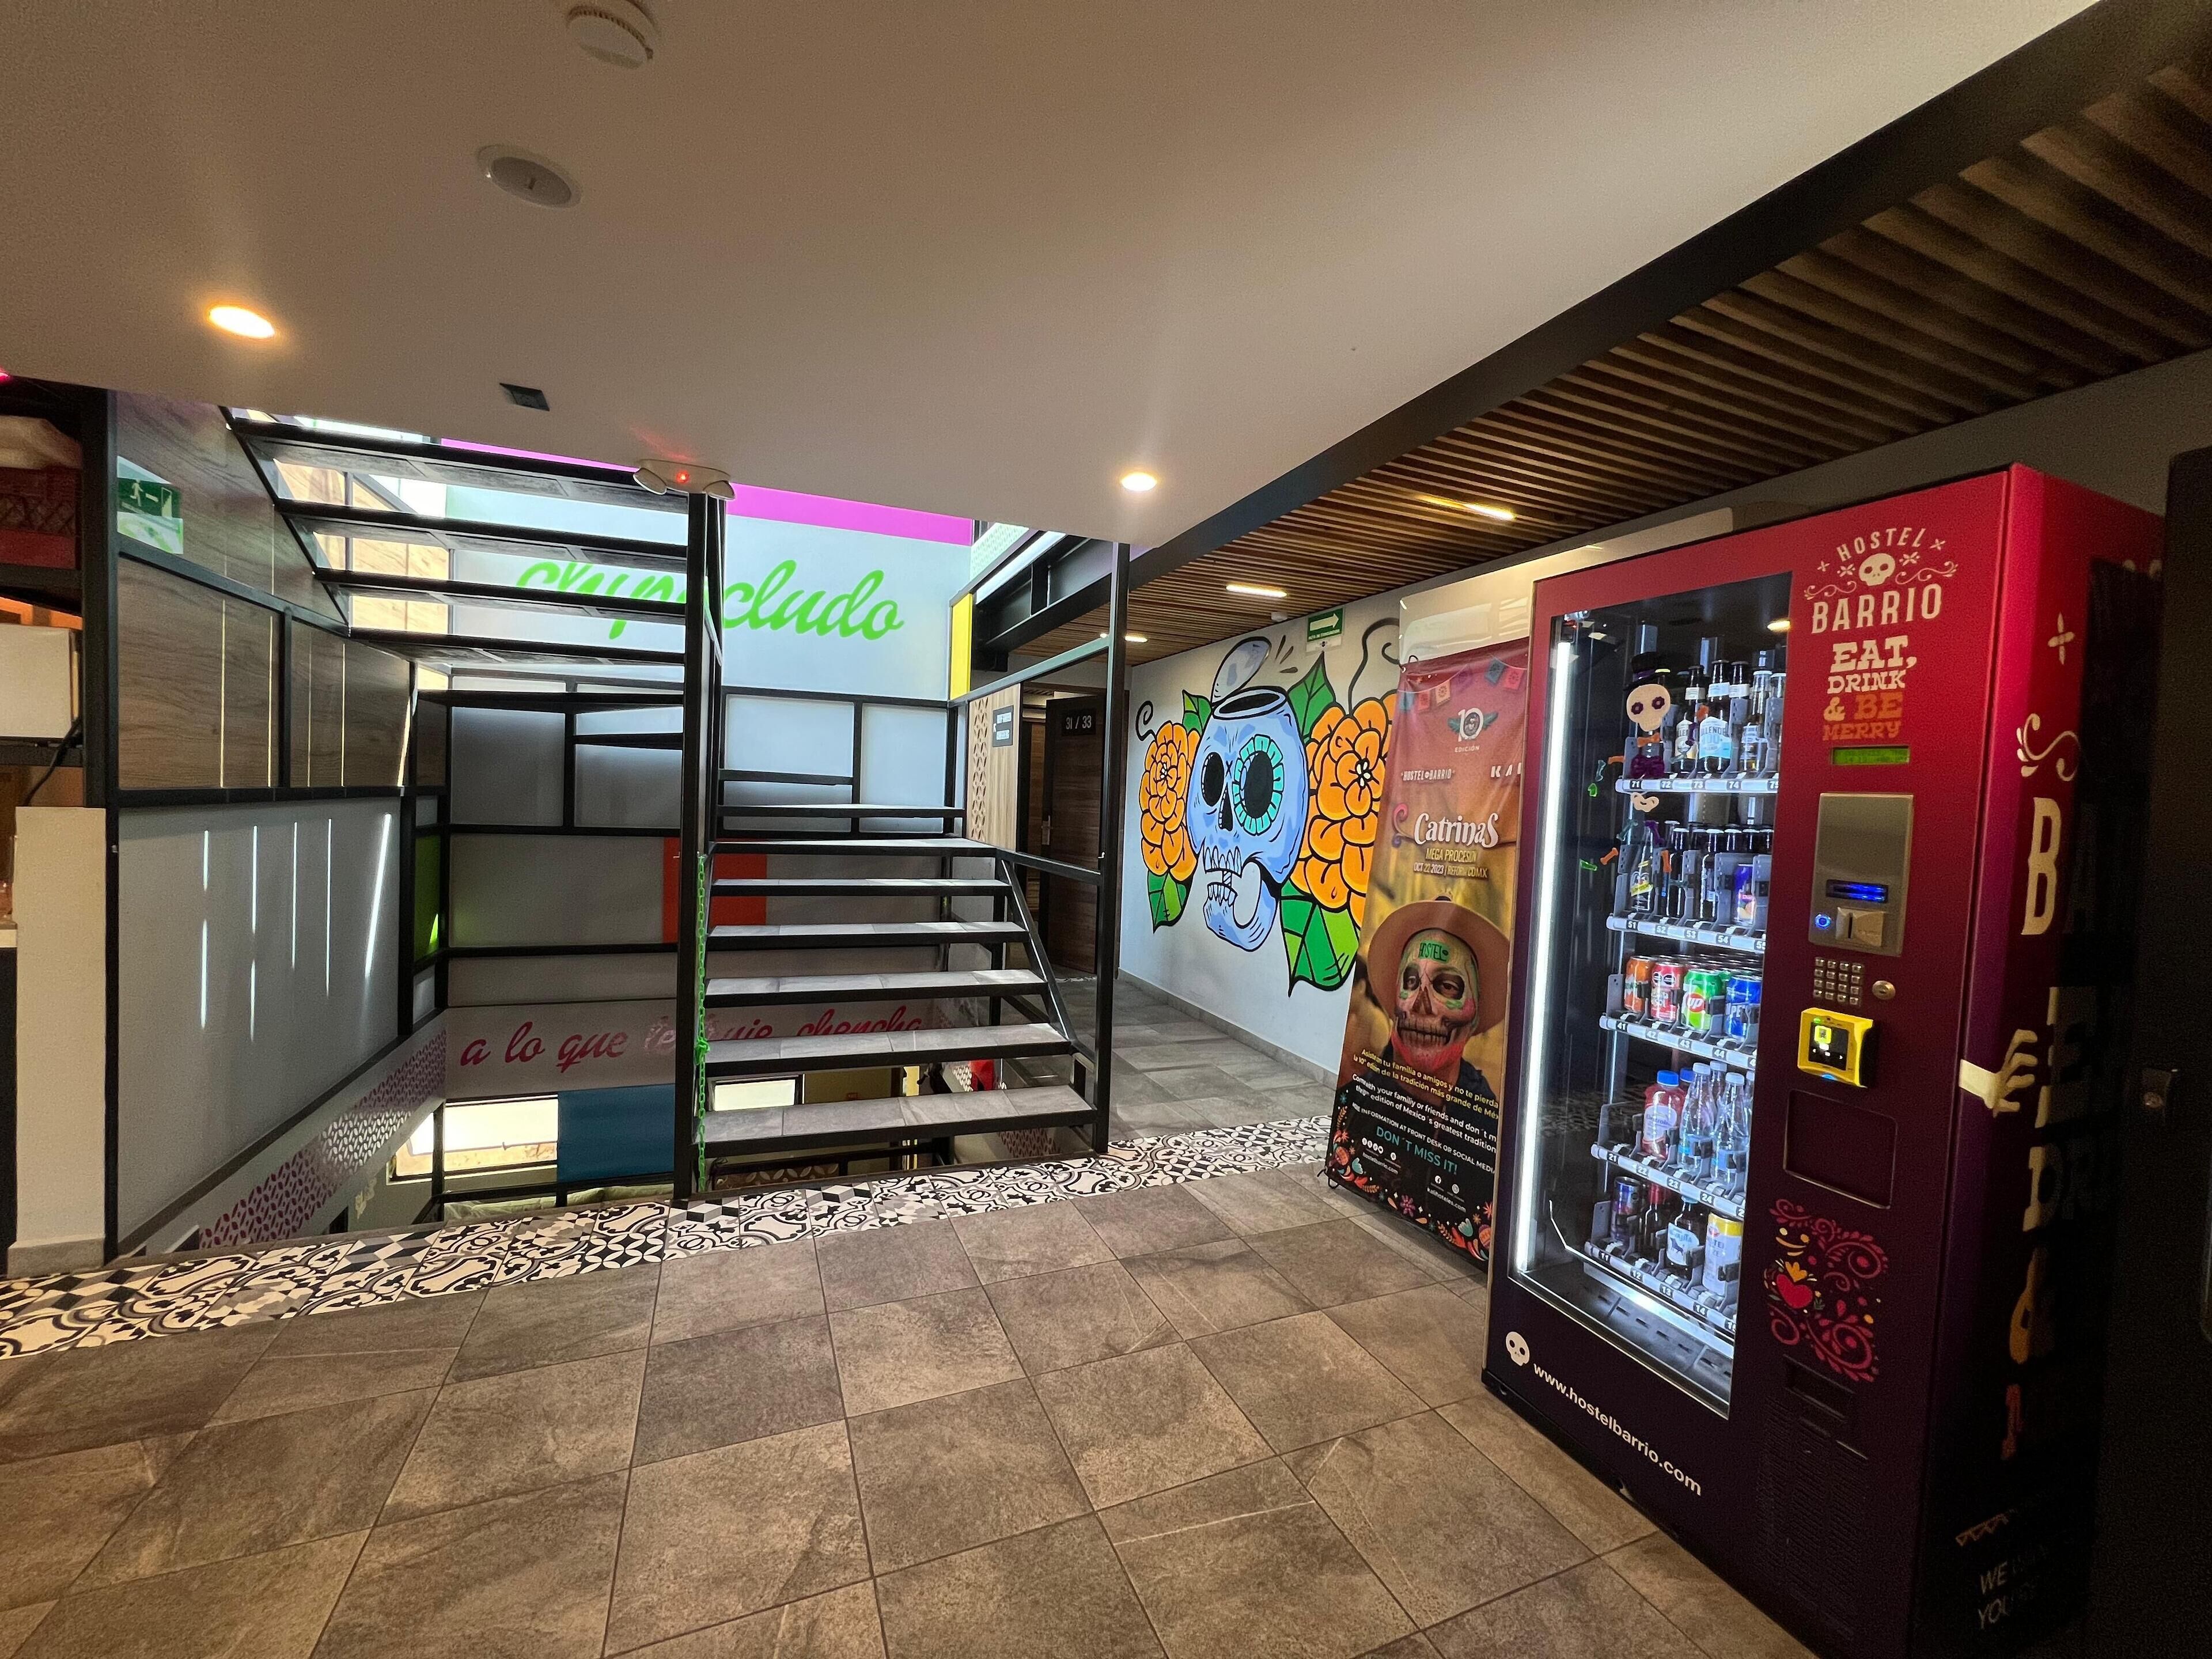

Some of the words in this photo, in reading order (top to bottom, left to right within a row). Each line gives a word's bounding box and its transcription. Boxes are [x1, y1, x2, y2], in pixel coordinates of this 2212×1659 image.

[1836, 527, 1926, 562] HOSTEL
[1810, 583, 1942, 634] BARRIO
[1830, 635, 1918, 673] EAT,
[1827, 669, 1907, 694] DRINK
[1066, 717, 1073, 730] 31
[1082, 715, 1092, 729] 33
[1823, 696, 1846, 722] &
[1853, 692, 1904, 720] BE
[1822, 720, 1903, 741] MERRY
[1662, 781, 1671, 789] 72
[1694, 781, 1704, 789] 73
[1729, 781, 1740, 789] 74
[1413, 862, 1424, 872] OCT
[1423, 863, 1430, 873] 22
[1430, 863, 1445, 874] 2023
[1425, 847, 1444, 861] MEGA
[1444, 849, 1479, 863] PROCESN
[1628, 922, 1637, 930] 51
[1656, 925, 1666, 933] 52
[1686, 930, 1696, 938] 53
[1718, 935, 1729, 944] 54
[460, 1037, 491, 1067] a
[503, 1021, 545, 1063] lo
[556, 1033, 628, 1072] que
[1617, 1022, 1626, 1031] 41
[1646, 1030, 1656, 1039] 42
[1680, 1039, 1690, 1048] 43
[1714, 1048, 1725, 1058] 44
[1381, 1069, 1391, 1077] de
[1392, 1071, 1399, 1080] la
[1400, 1075, 1429, 1091] tradición
[1431, 1087, 1445, 1098] más
[1446, 1093, 1471, 1109] grande
[1472, 1104, 1482, 1113] de
[1392, 1062, 1416, 1076] familia
[1423, 1074, 1448, 1088] amigos
[1448, 1084, 1453, 1092] y
[1455, 1086, 1464, 1094] no
[1465, 1090, 1473, 1098] te
[1475, 1094, 1498, 1109] pierda
[1370, 1094, 1395, 1108] edition
[1395, 1103, 1403, 1111] of
[1434, 1120, 1463, 1139] greatest
[1464, 1133, 1497, 1154] tradition
[1377, 1087, 1393, 1097] your
[1425, 1104, 1449, 1121] friends
[1449, 1116, 1464, 1128] and
[1361, 1108, 1399, 1129] INFORMATION
[1407, 1127, 1426, 1141] FRONT
[1427, 1137, 1442, 1149] DESK
[1443, 1145, 1452, 1153] OR
[1453, 1149, 1475, 1165] SOCIAL
[1414, 1144, 1441, 1166] MISS
[1444, 1158, 1458, 1175] IT!
[1608, 1153, 1617, 1162] 21
[1637, 1166, 1647, 1176] 22
[1668, 1179, 1679, 1189] 23
[1702, 1194, 1713, 1204] 24
[1600, 1252, 1609, 1261] 11
[1631, 1270, 1641, 1280] 12
[1661, 1286, 1671, 1296] 13
[1696, 1304, 1706, 1315] 14
[1533, 1363, 1702, 1497] www.hostelbarrio.com
